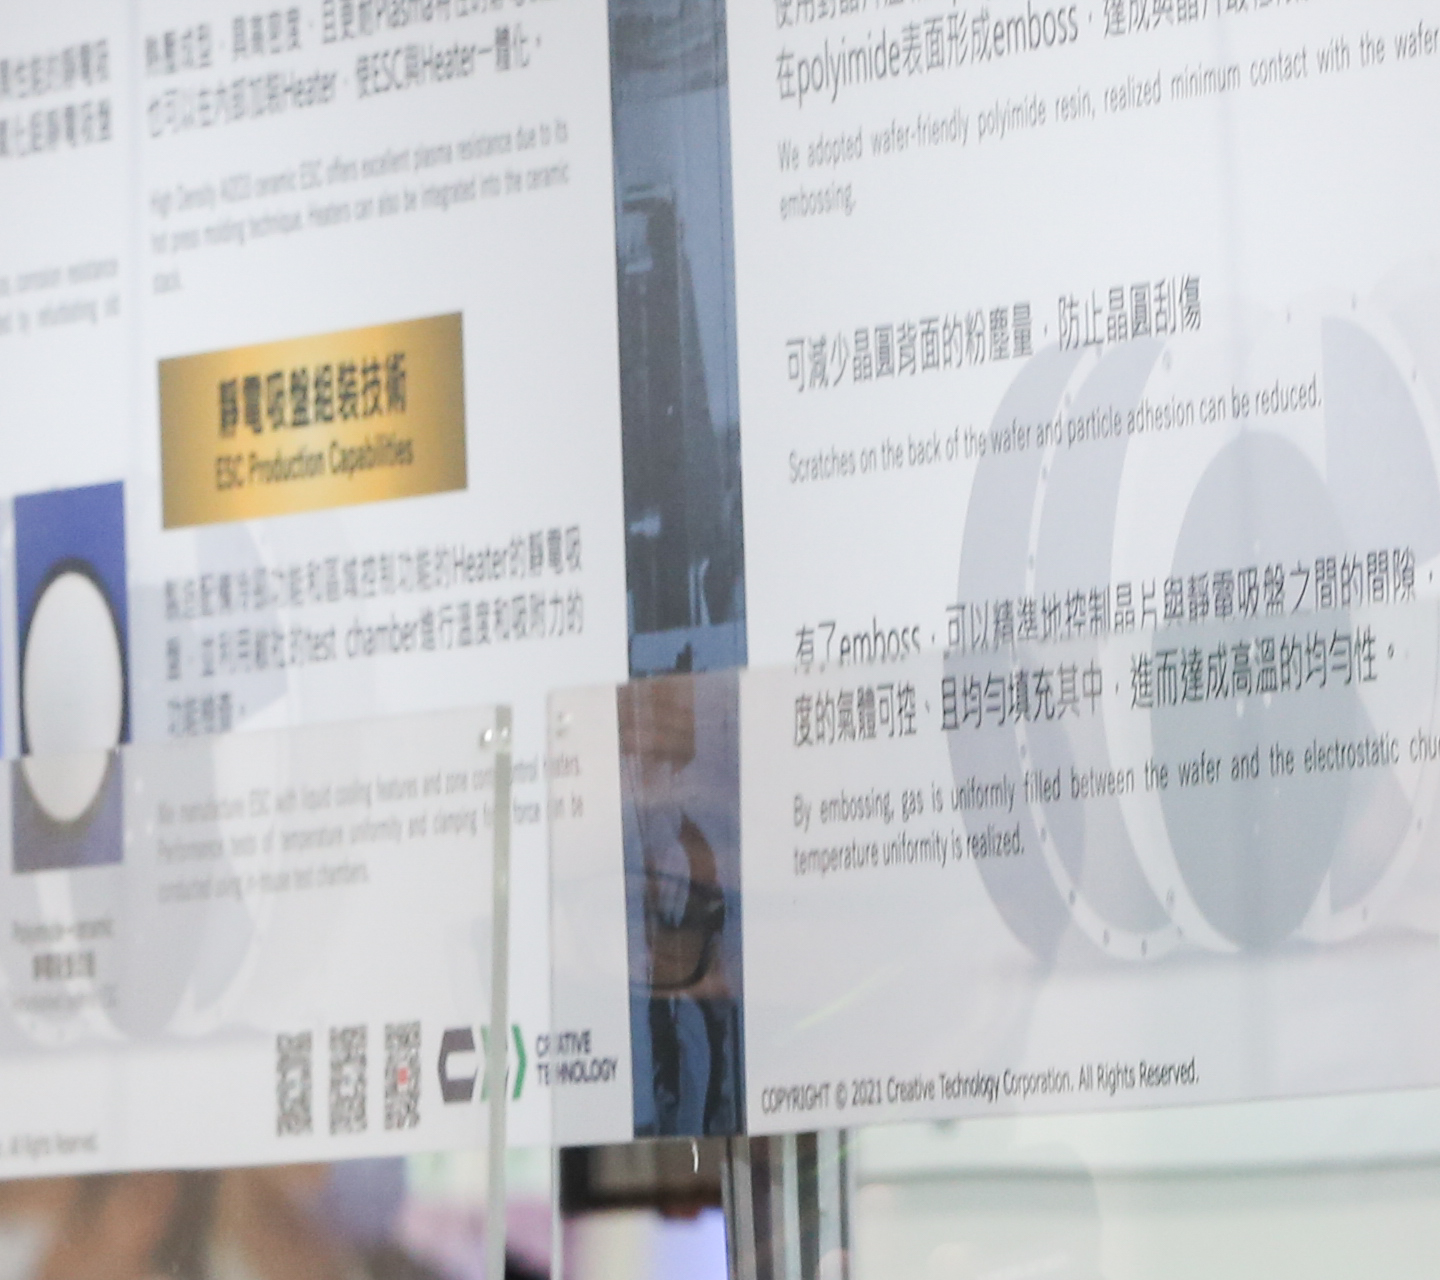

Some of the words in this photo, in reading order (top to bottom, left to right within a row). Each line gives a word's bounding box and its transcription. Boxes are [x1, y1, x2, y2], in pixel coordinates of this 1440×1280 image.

[777, 138, 800, 173] We
[807, 125, 863, 170] adopted
[871, 107, 969, 157] wafer-friendly
[978, 93, 1046, 144] polyimide
[1055, 86, 1096, 122] resin,
[1104, 70, 1161, 113] realized
[1170, 61, 1240, 101] minimum
[1249, 46, 1307, 87] contact
[1316, 34, 1350, 77] with
[1359, 30, 1386, 67] the
[1394, 20, 1439, 62] wafer
[788, 444, 857, 485] Scratches
[860, 446, 879, 471] on
[881, 437, 903, 470] the
[907, 431, 942, 465] back
[945, 426, 961, 461] of
[962, 425, 987, 458] the
[990, 424, 1032, 456] wafer
[1036, 418, 1062, 448] and
[1066, 407, 1123, 449] particle
[1126, 396, 1195, 438] adhesion
[1198, 402, 1227, 423] can
[1230, 388, 1251, 418] be
[1255, 372, 1323, 415] reduced.
[215, 452, 244, 491] ESC
[249, 442, 325, 484] Production
[329, 430, 414, 481] Capabilities
[793, 792, 812, 833] By
[820, 786, 895, 825] embossing,
[901, 788, 923, 824] gas
[931, 779, 944, 812] is
[950, 774, 1016, 813] uniformly
[1023, 766, 1062, 805] filled
[1070, 762, 1135, 800] between
[1144, 758, 1169, 792] the
[1178, 749, 1222, 788] wafer
[1231, 743, 1260, 781] and
[1269, 741, 1295, 775] the
[1303, 730, 1399, 774] electrostatic
[794, 838, 879, 876] temperature
[883, 828, 948, 869] uniformity
[951, 832, 963, 859] is
[966, 821, 1025, 860] realized.
[534, 1029, 593, 1060] CRATIVE
[534, 1055, 619, 1087] TEHNOLOGY
[761, 1082, 831, 1116] COPYRIGHT
[852, 1076, 883, 1107] 2021
[886, 1073, 935, 1104] Creative
[938, 1069, 1000, 1104] Technology
[1002, 1066, 1074, 1101] Corporation.
[1078, 1062, 1094, 1090] All
[1096, 1060, 1135, 1097] Rights
[1138, 1055, 1201, 1087] Reserved.
